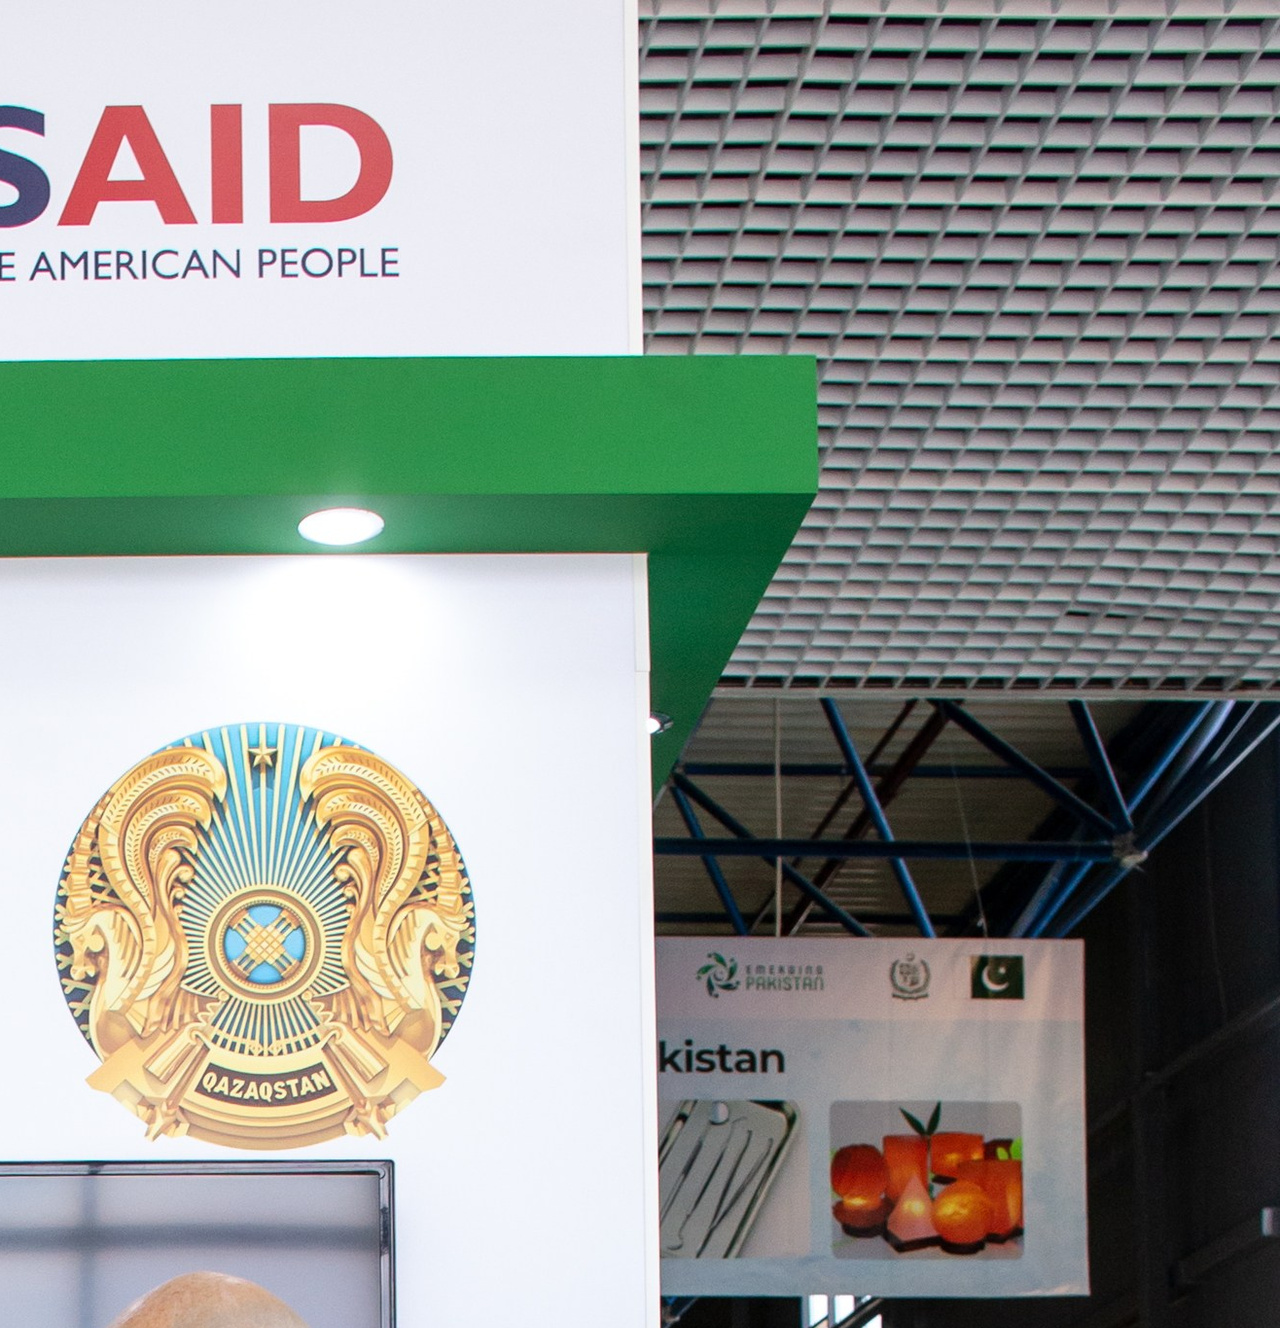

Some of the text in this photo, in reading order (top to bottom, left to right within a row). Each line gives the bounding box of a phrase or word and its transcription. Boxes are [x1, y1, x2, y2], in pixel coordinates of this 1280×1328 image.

[29, 249, 241, 281] AMERICAN
[257, 247, 400, 278] PEOPLE
[658, 1039, 785, 1073] kistan
[202, 1070, 331, 1102] QAZAQSTAN
